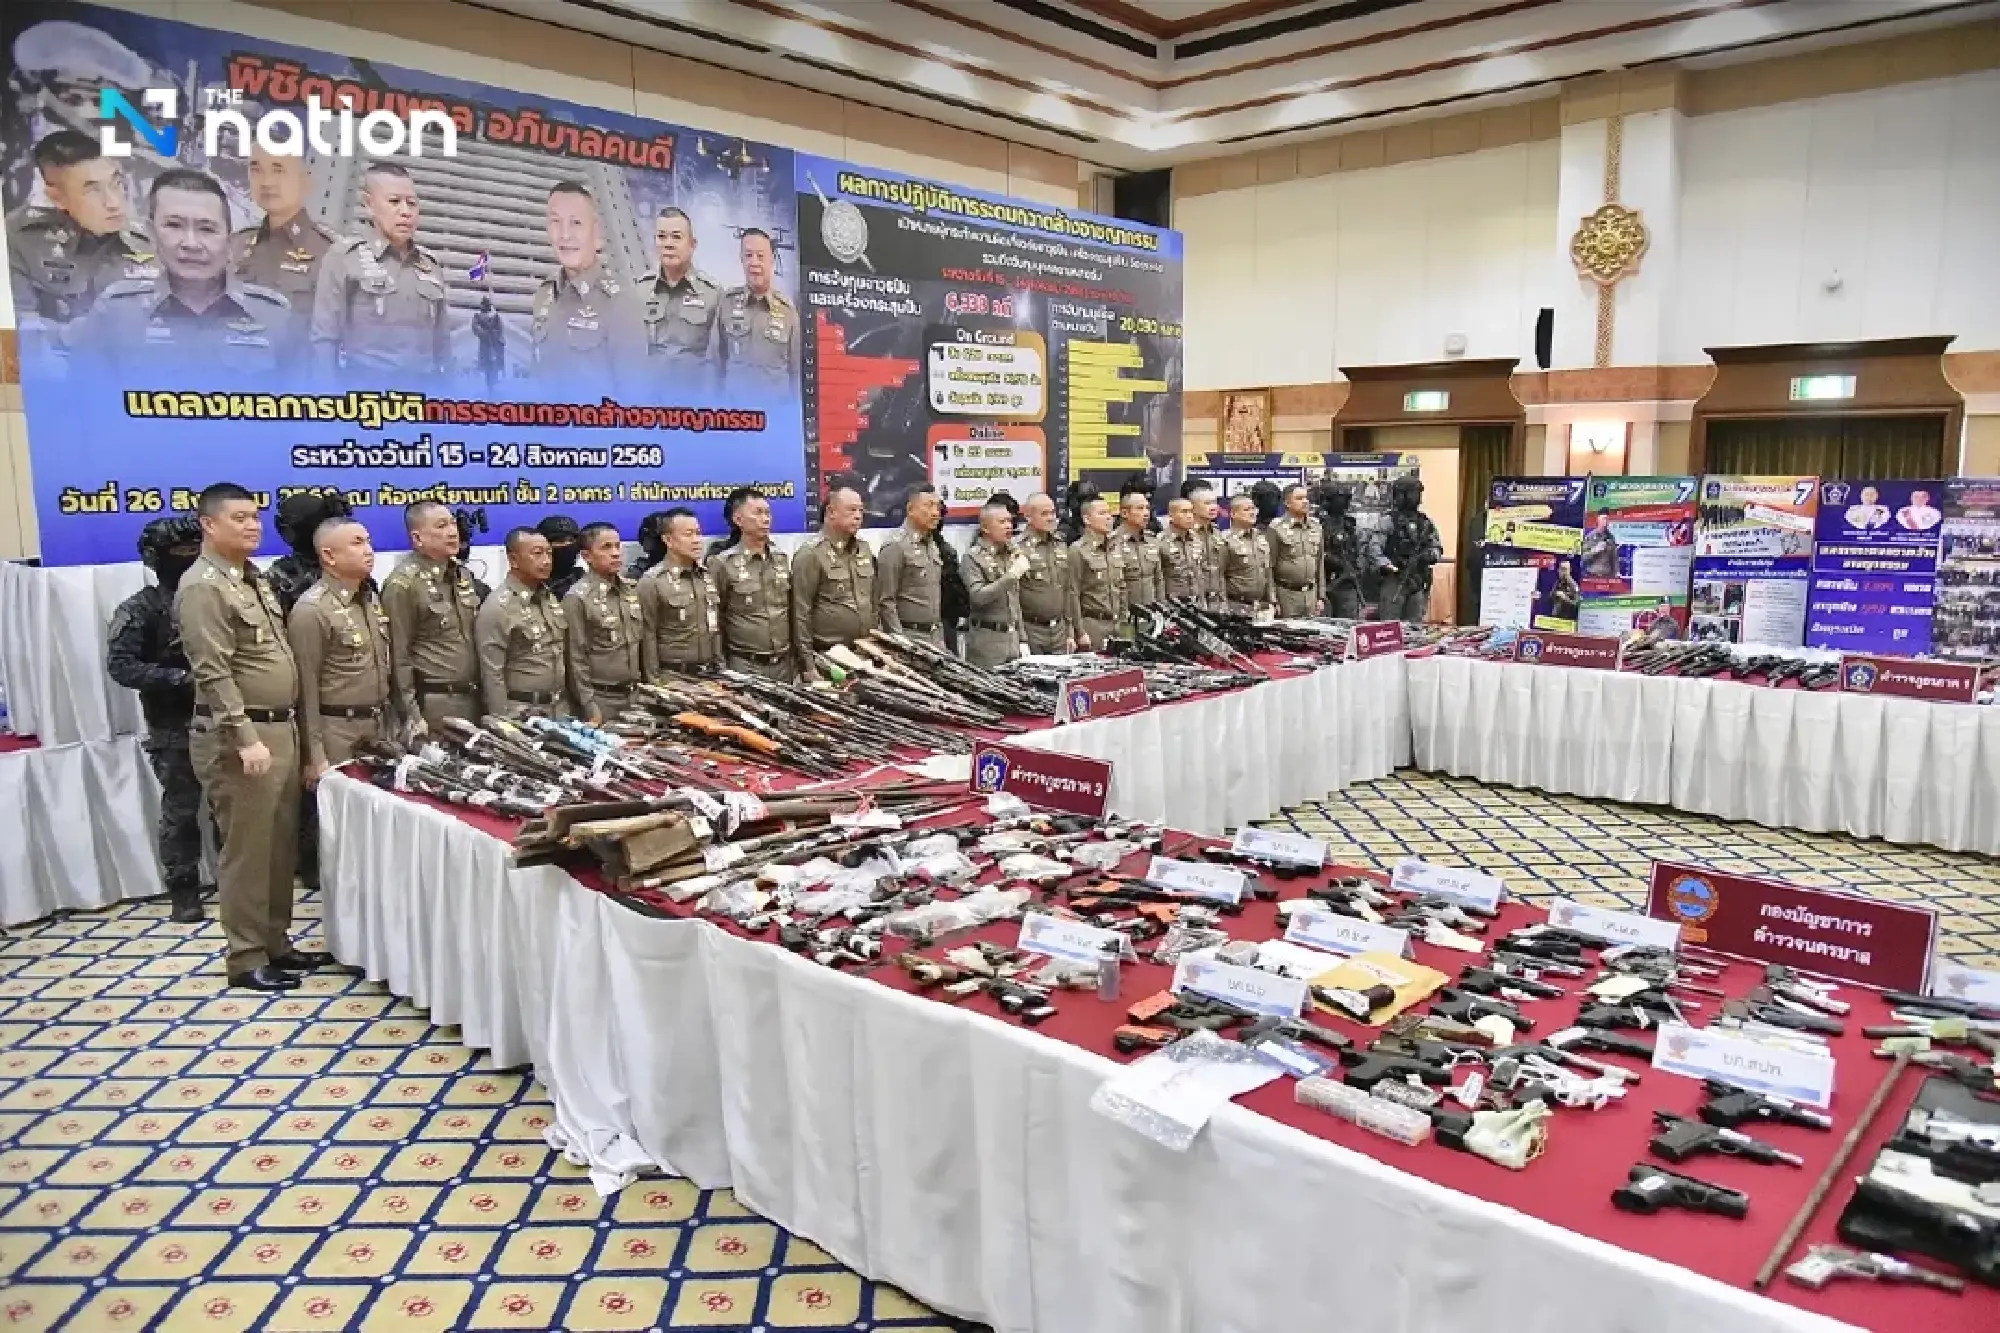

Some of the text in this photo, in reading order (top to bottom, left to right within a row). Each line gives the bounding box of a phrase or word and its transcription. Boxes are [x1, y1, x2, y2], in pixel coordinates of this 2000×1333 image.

[488, 110, 674, 169] อภิบาลคนดี
[956, 327, 1015, 345] On Ground
[292, 434, 432, 468] ระหว่างวันที่
[438, 442, 465, 468] 15
[487, 442, 520, 469] 24
[526, 445, 607, 467] สิงหาคม
[612, 443, 662, 467] 2568
[60, 481, 118, 514] วันที่
[125, 486, 161, 512] 26
[515, 478, 541, 505] ชั้น
[546, 484, 559, 504] 2
[562, 487, 613, 503] อาคาร
[616, 482, 625, 502] 1
[1569, 481, 1584, 503] 7
[1675, 481, 1695, 503] 7
[1793, 481, 1816, 505] 7
[1010, 764, 1103, 797] ตำรวจภูธรภาค 3
[1760, 904, 1873, 938] กองบัญชาการ
[1753, 925, 1871, 966] ตำรวจนครบาล
